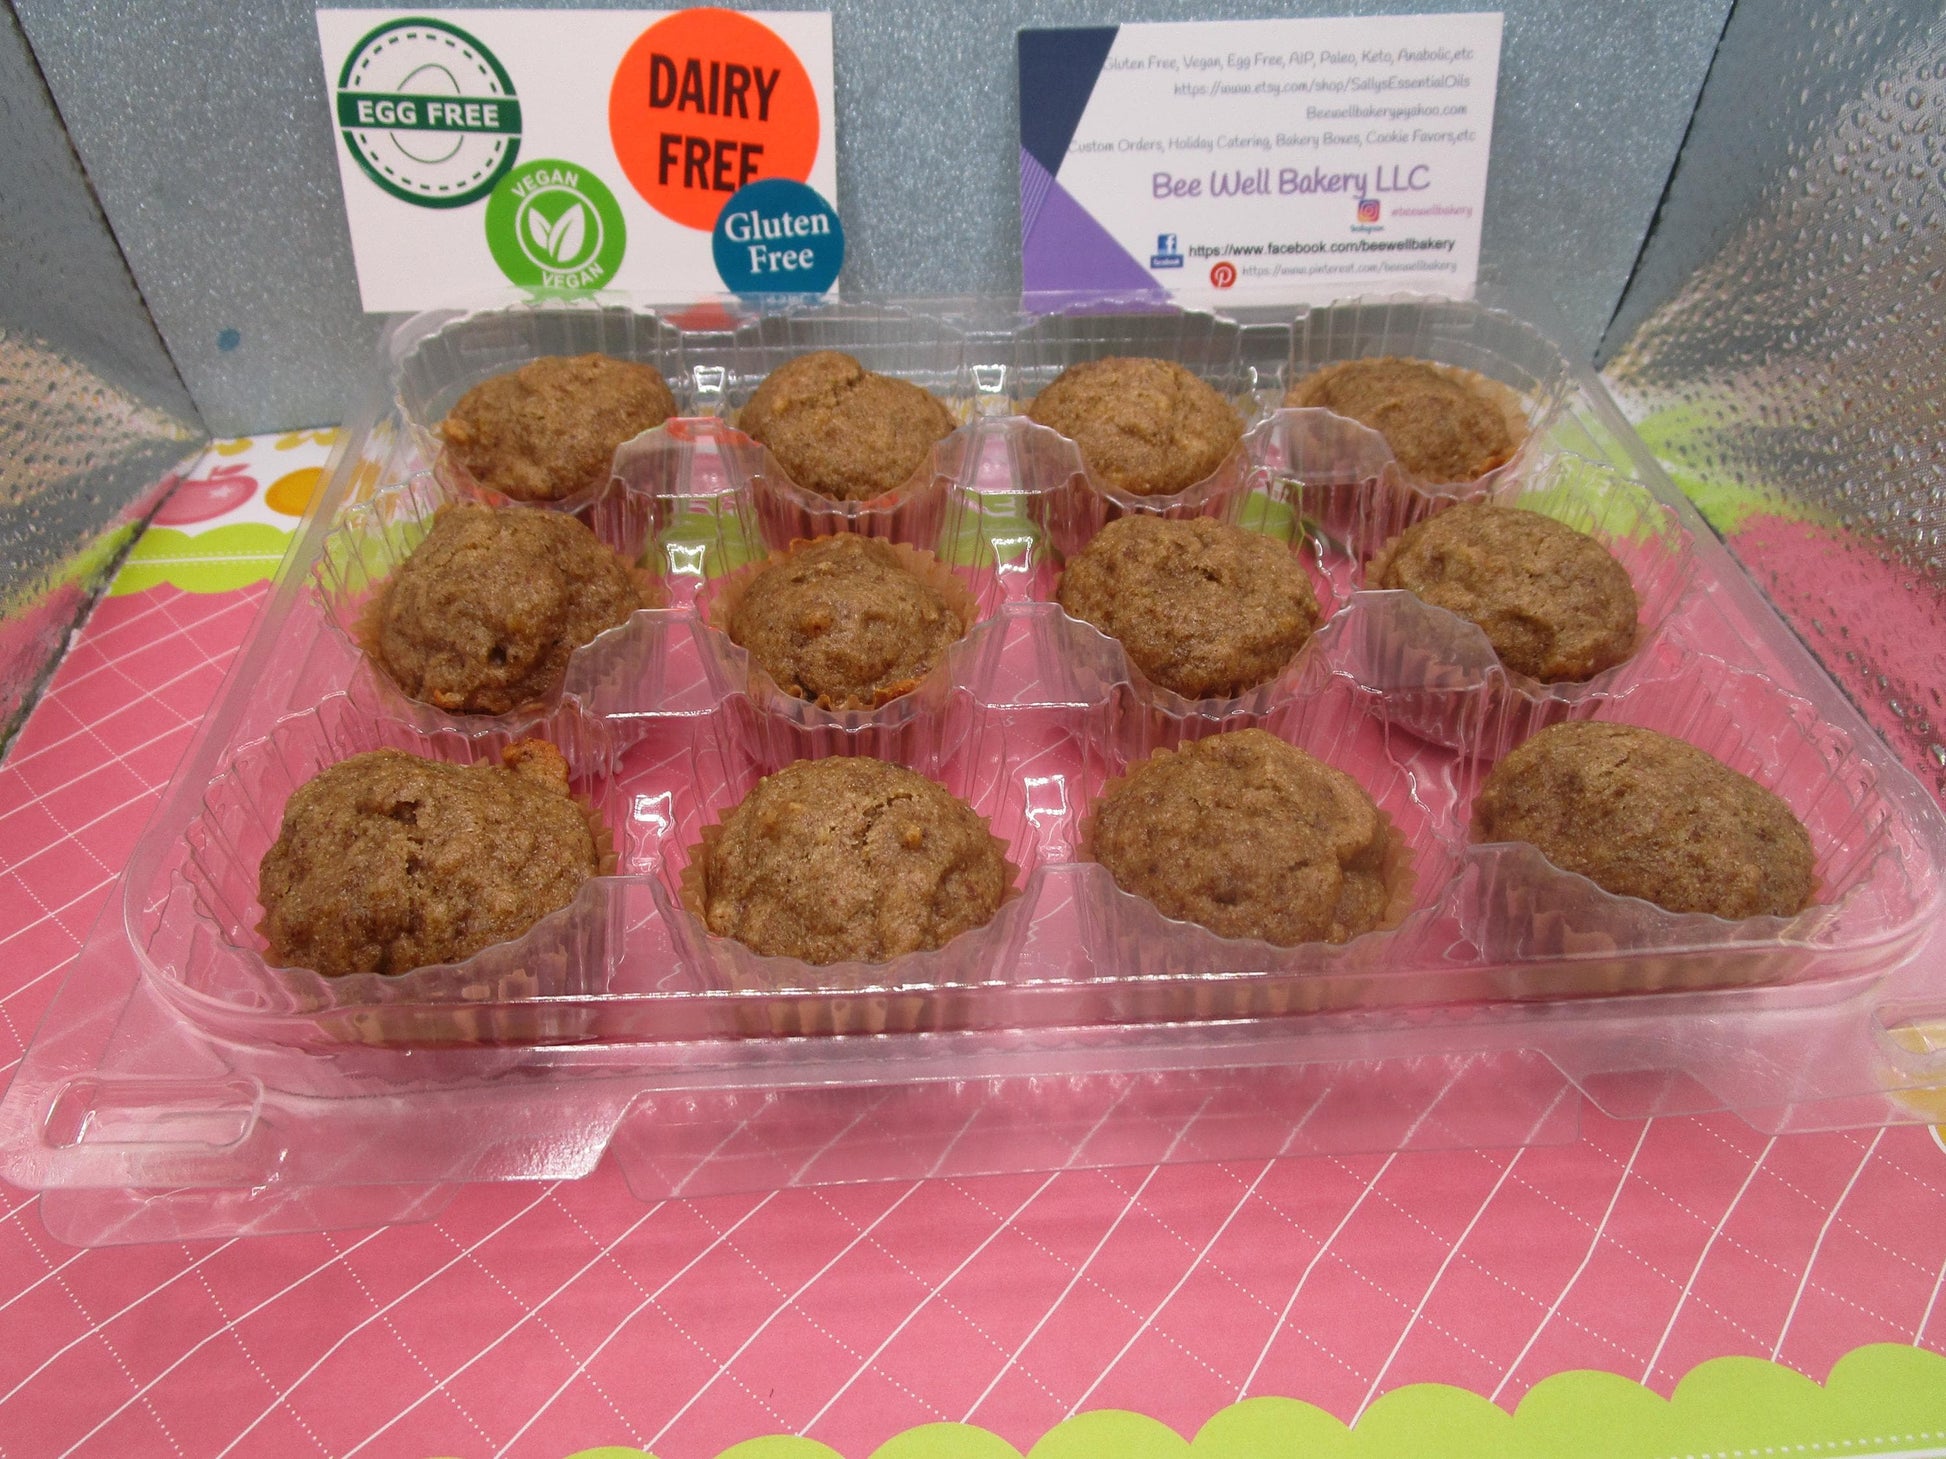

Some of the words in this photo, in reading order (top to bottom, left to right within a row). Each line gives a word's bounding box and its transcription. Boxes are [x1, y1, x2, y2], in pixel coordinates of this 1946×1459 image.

[1102, 56, 1145, 71] Gluten
[1149, 55, 1180, 72] Free,
[1184, 54, 1223, 71] Vegan,
[1227, 53, 1251, 70] Egg
[1254, 52, 1286, 69] Free,
[1320, 50, 1358, 67] Paleo,
[1362, 49, 1395, 66] Keto,
[648, 52, 781, 122] DAIRY
[357, 100, 418, 124] EGG
[427, 102, 500, 128] FREE
[1069, 139, 1114, 152] Custom
[1118, 137, 1165, 153] Orders,
[1169, 136, 1213, 152] Holiday
[1217, 134, 1273, 151] Catering,
[1275, 133, 1320, 148] Bakery
[1323, 131, 1363, 147] Boxes,
[1366, 129, 1409, 143] Cookie
[658, 132, 765, 193] FREE
[511, 169, 579, 199] VEGAN
[1152, 172, 1202, 198] Bee
[1210, 168, 1271, 197] Well
[1279, 166, 1368, 200] Bakery
[1376, 164, 1431, 192] LLC
[724, 209, 831, 243] Gluten
[747, 245, 814, 274] Free
[541, 262, 605, 289] VEGAN
